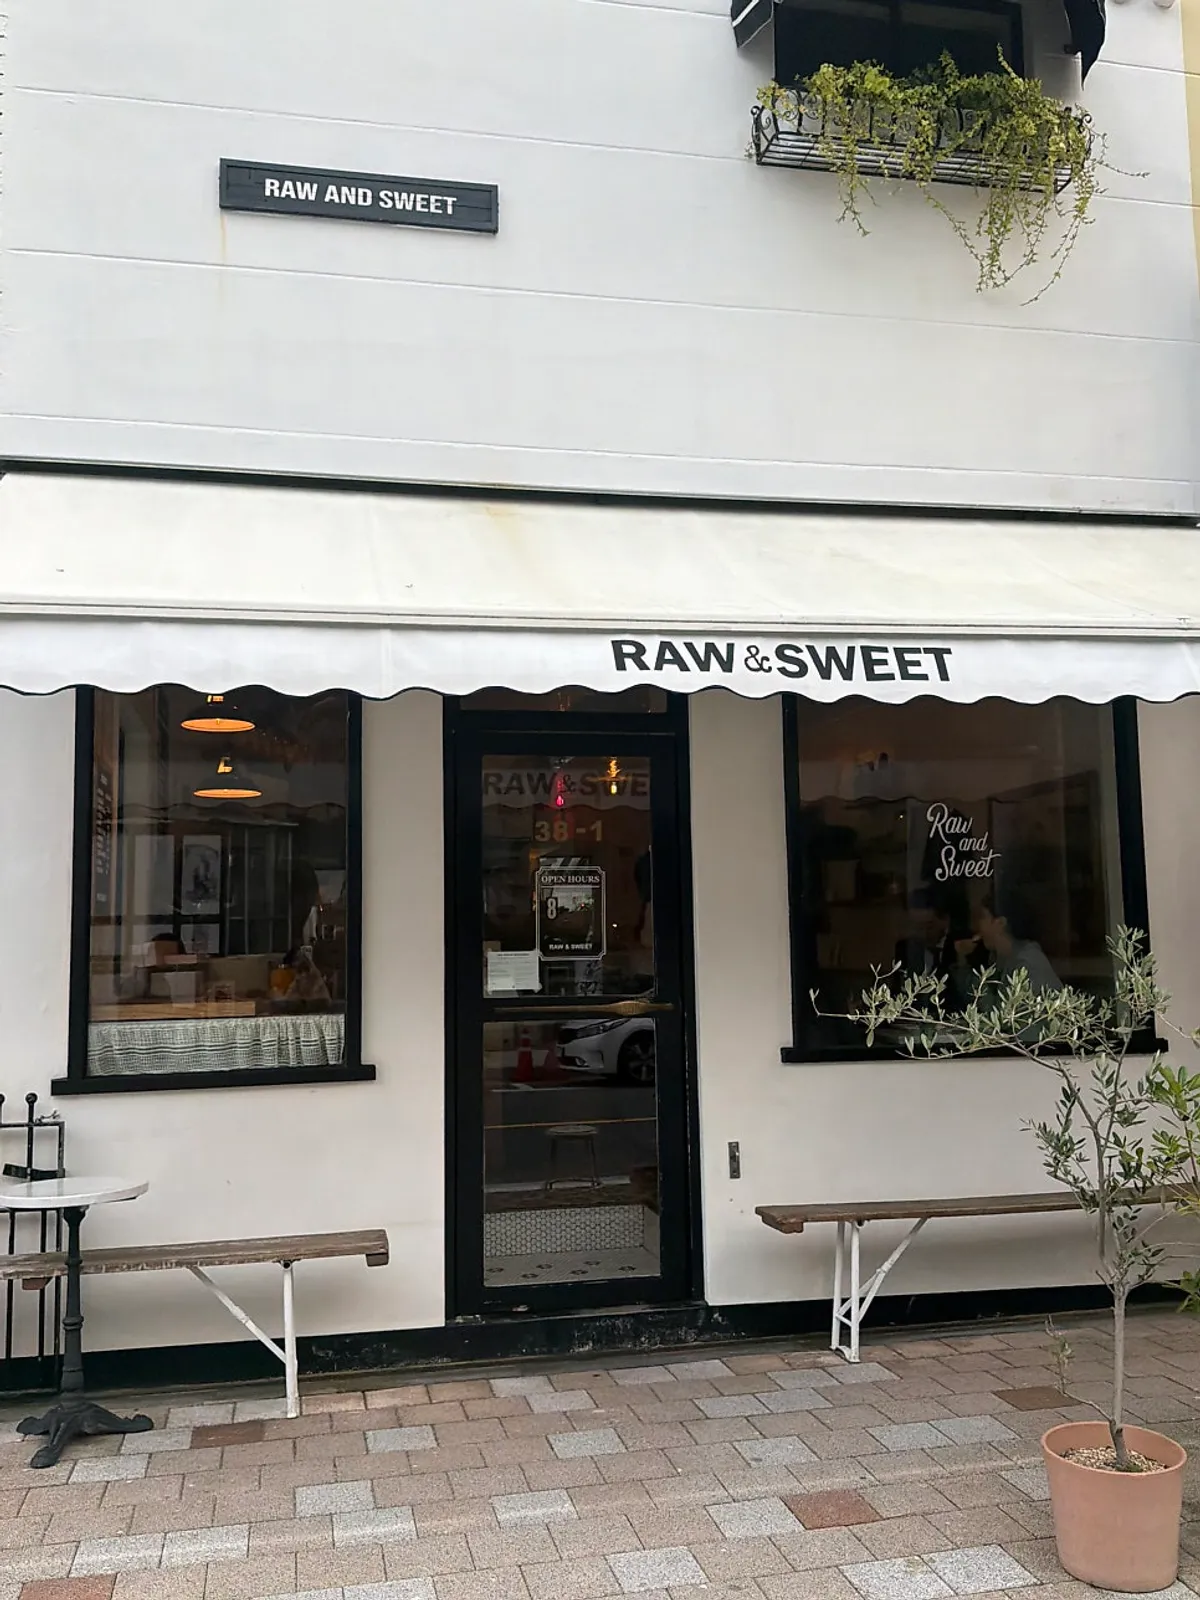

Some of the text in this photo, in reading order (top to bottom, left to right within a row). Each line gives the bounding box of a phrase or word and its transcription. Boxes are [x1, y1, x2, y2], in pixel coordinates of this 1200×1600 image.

[264, 178, 458, 215] RAW AND SWEET
[611, 639, 952, 682] RAW & SWEET
[484, 772, 558, 795] RAW
[535, 820, 603, 842] 38-1
[926, 802, 973, 844] Raw
[958, 831, 989, 851] and
[935, 845, 1002, 881] Sweet
[541, 875, 600, 884] OPEN HOURS
[546, 898, 557, 920] 8
